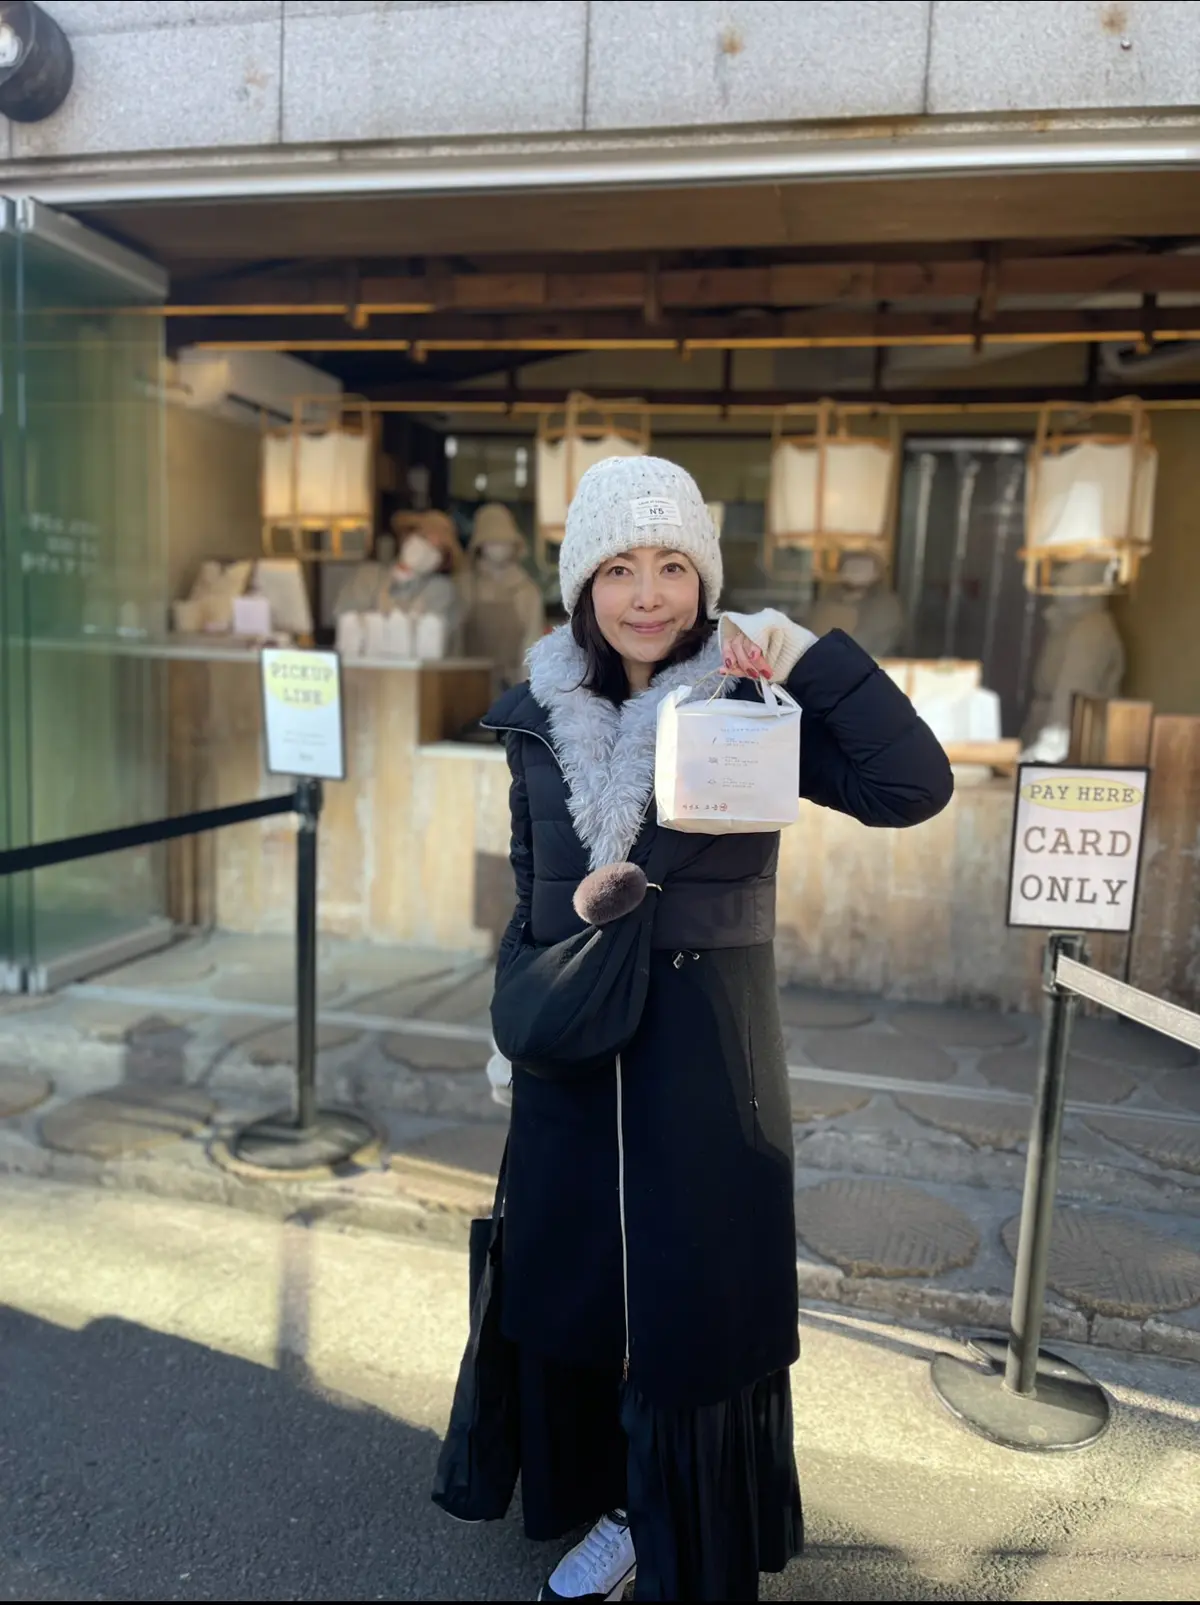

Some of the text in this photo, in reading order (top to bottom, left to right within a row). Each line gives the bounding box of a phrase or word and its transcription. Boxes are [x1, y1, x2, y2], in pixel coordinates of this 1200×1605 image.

[271, 661, 334, 683] PICKUP
[284, 687, 323, 705] LINE
[1030, 785, 1135, 803] PAY HERE
[1023, 826, 1132, 857] CARD
[1020, 874, 1128, 905] ONLY
